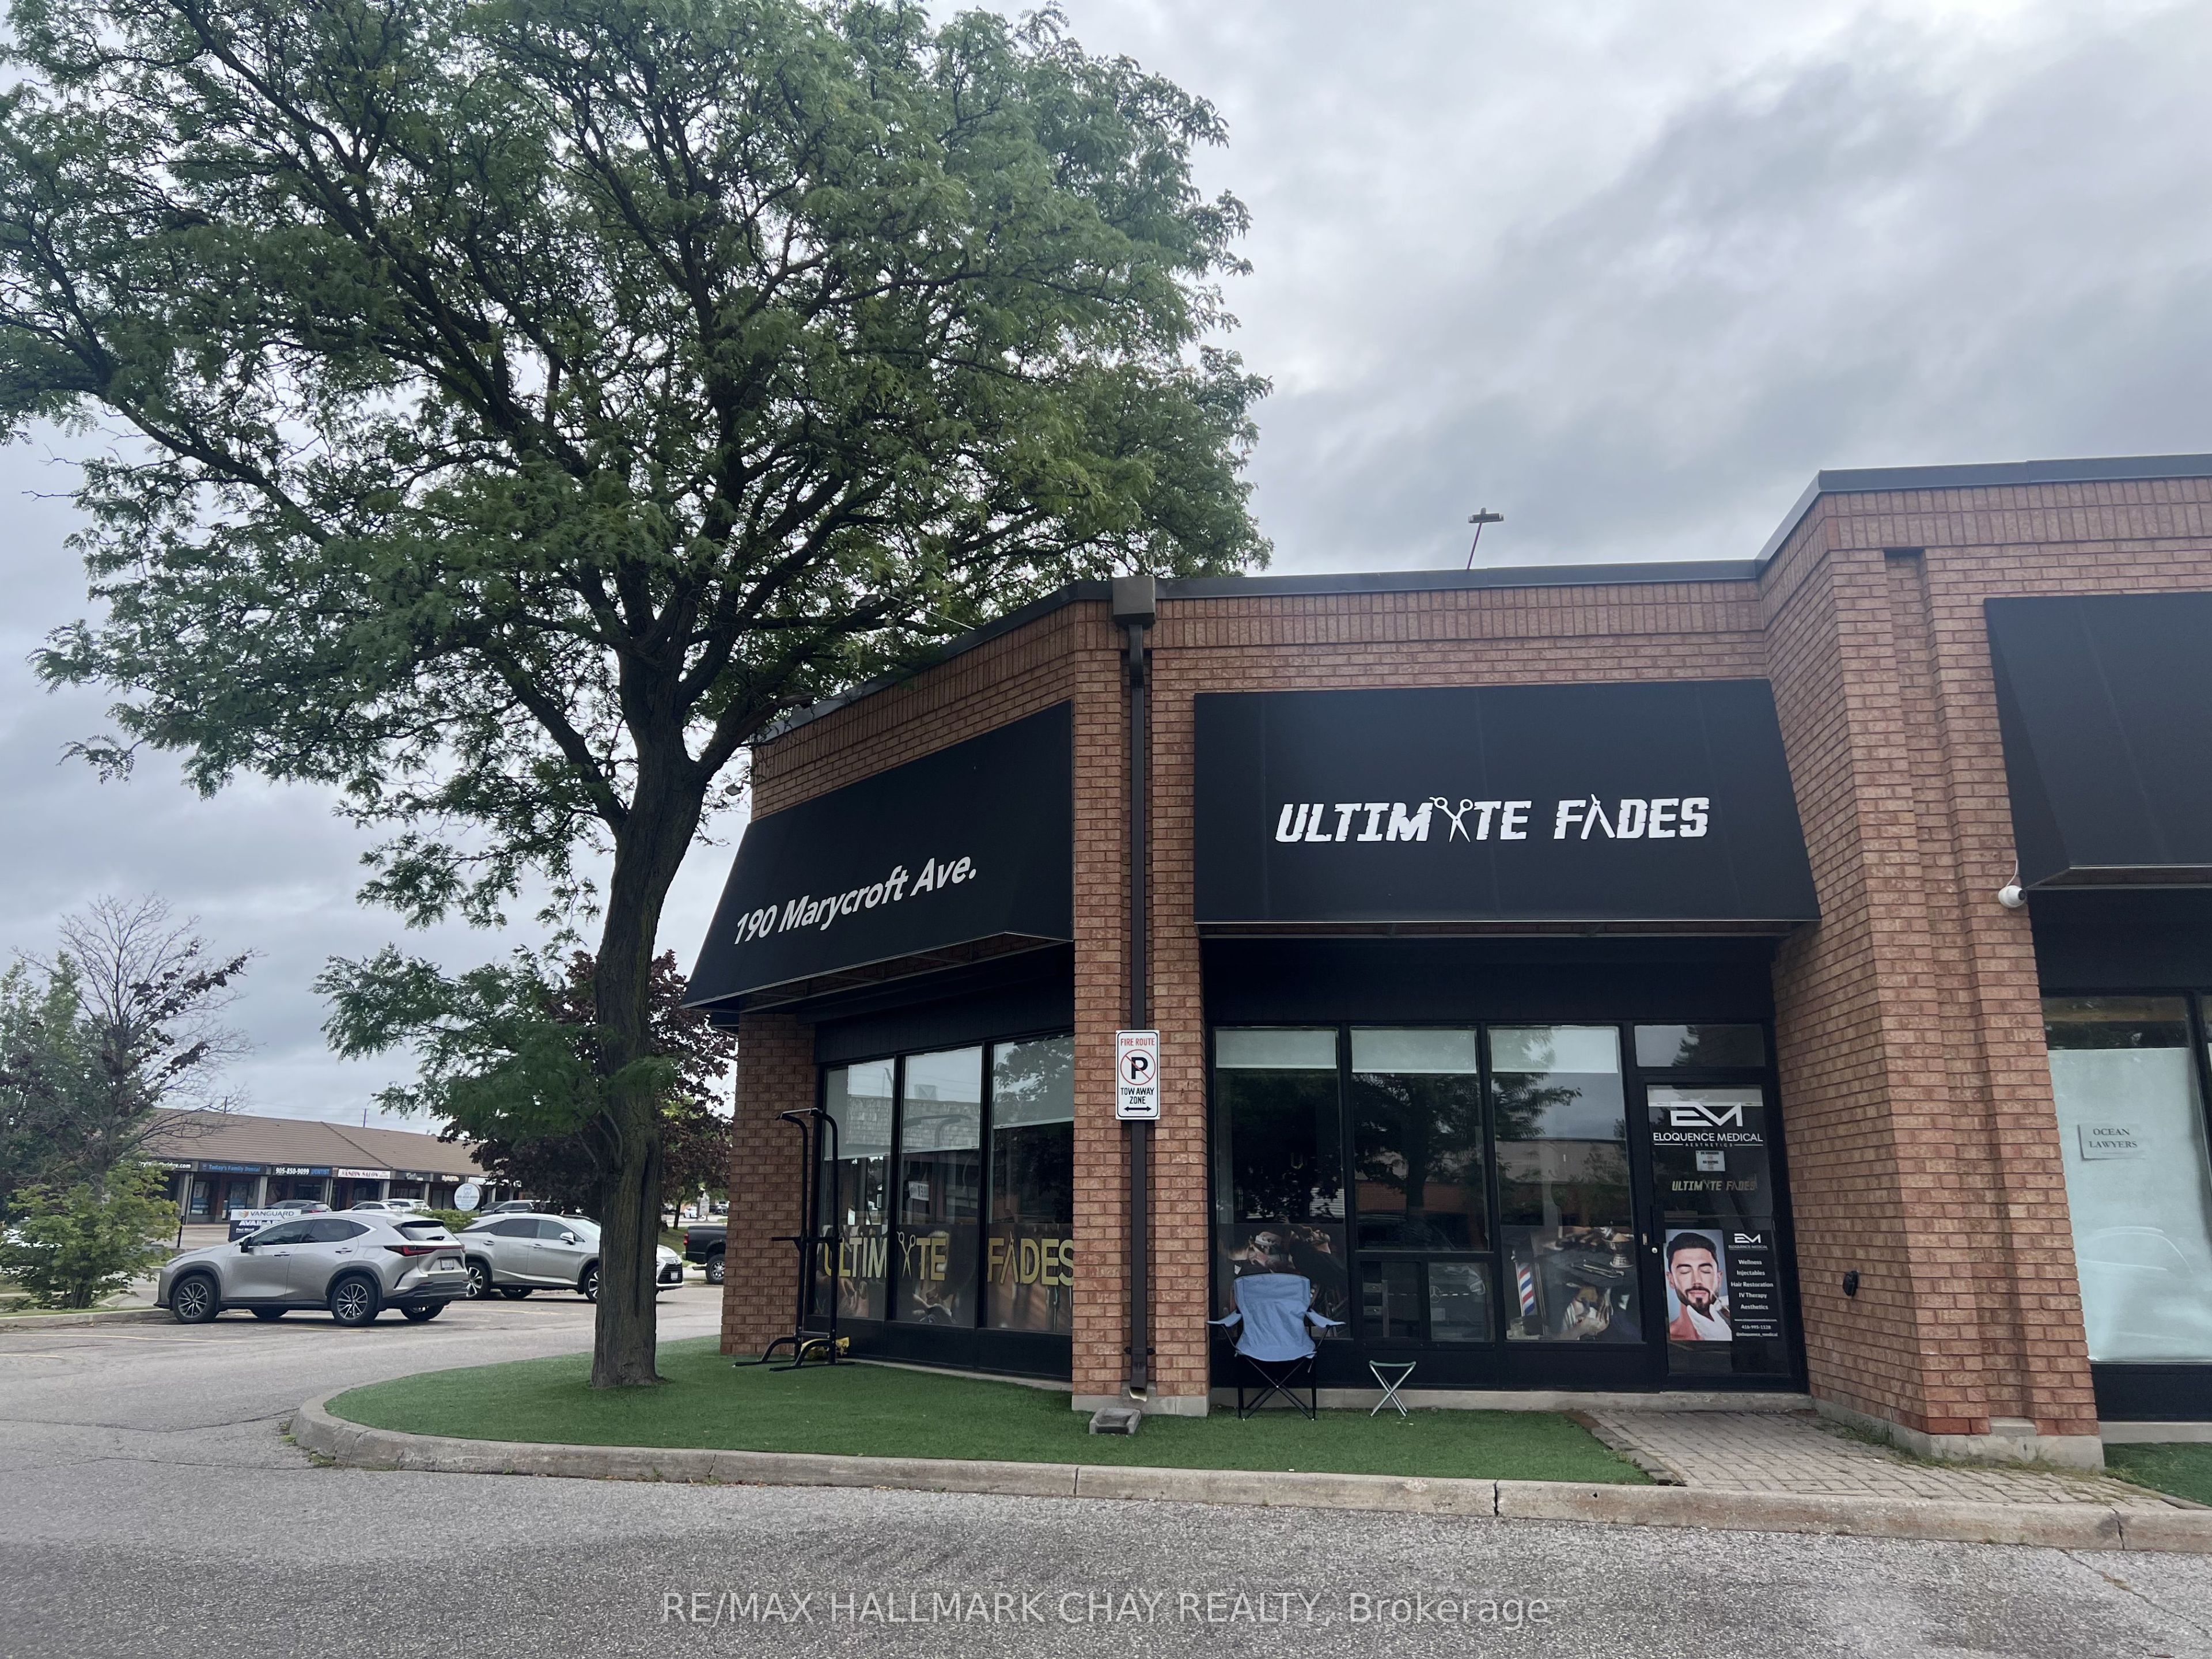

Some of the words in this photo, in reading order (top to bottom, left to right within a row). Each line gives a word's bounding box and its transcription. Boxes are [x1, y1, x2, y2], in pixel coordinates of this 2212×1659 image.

[734, 904, 778, 945] 190
[778, 865, 909, 933] Marycroft
[910, 856, 977, 897] Ave.
[1120, 1038, 1134, 1046] FIRE
[1135, 1038, 1155, 1046] ROUTE
[1120, 1088, 1135, 1096] TOW
[1137, 1088, 1154, 1096] AWAY
[1129, 1096, 1146, 1104] ZONE
[2093, 1128, 2130, 1136] OCEAN
[1653, 1132, 1715, 1142] ELOQUENCE
[1717, 1132, 1763, 1142] MEDICAL
[275, 1167, 310, 1175] 905-850-9099
[251, 1211, 294, 1219] VANGUARD
